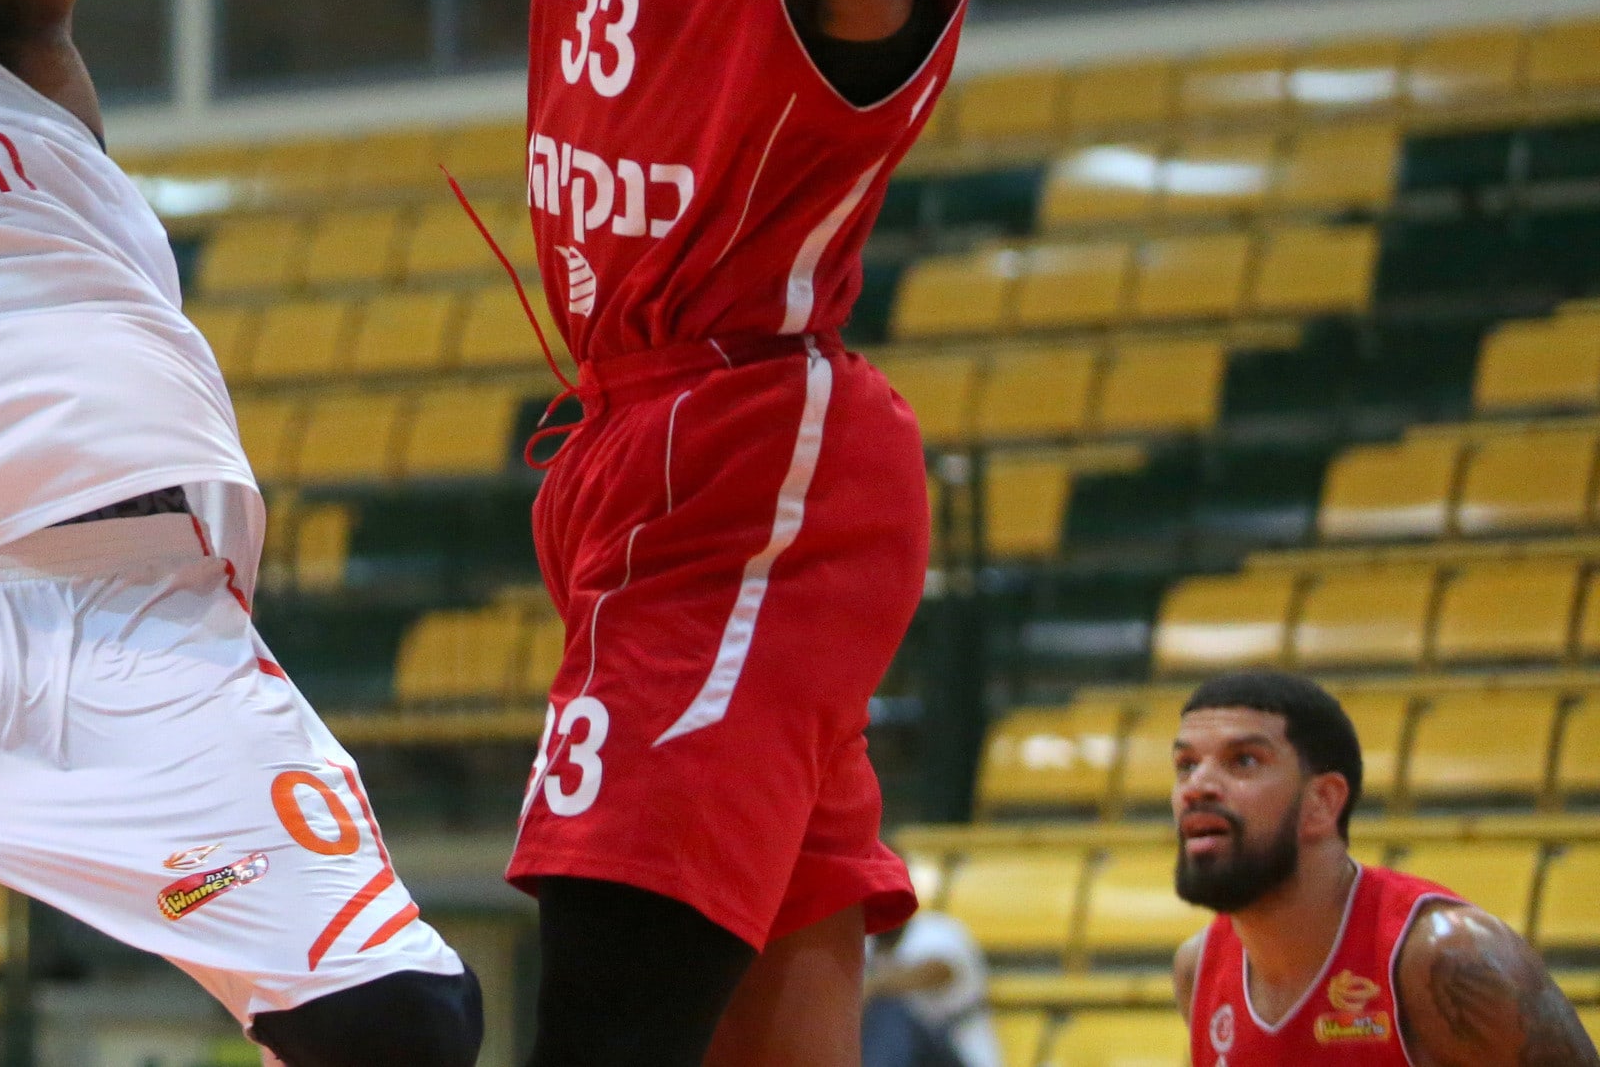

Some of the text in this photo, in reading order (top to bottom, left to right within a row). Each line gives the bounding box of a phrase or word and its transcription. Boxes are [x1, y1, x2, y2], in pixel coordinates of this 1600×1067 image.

[271, 770, 360, 856] 0
[166, 875, 235, 912] Winner
[205, 866, 233, 884] ליגת
